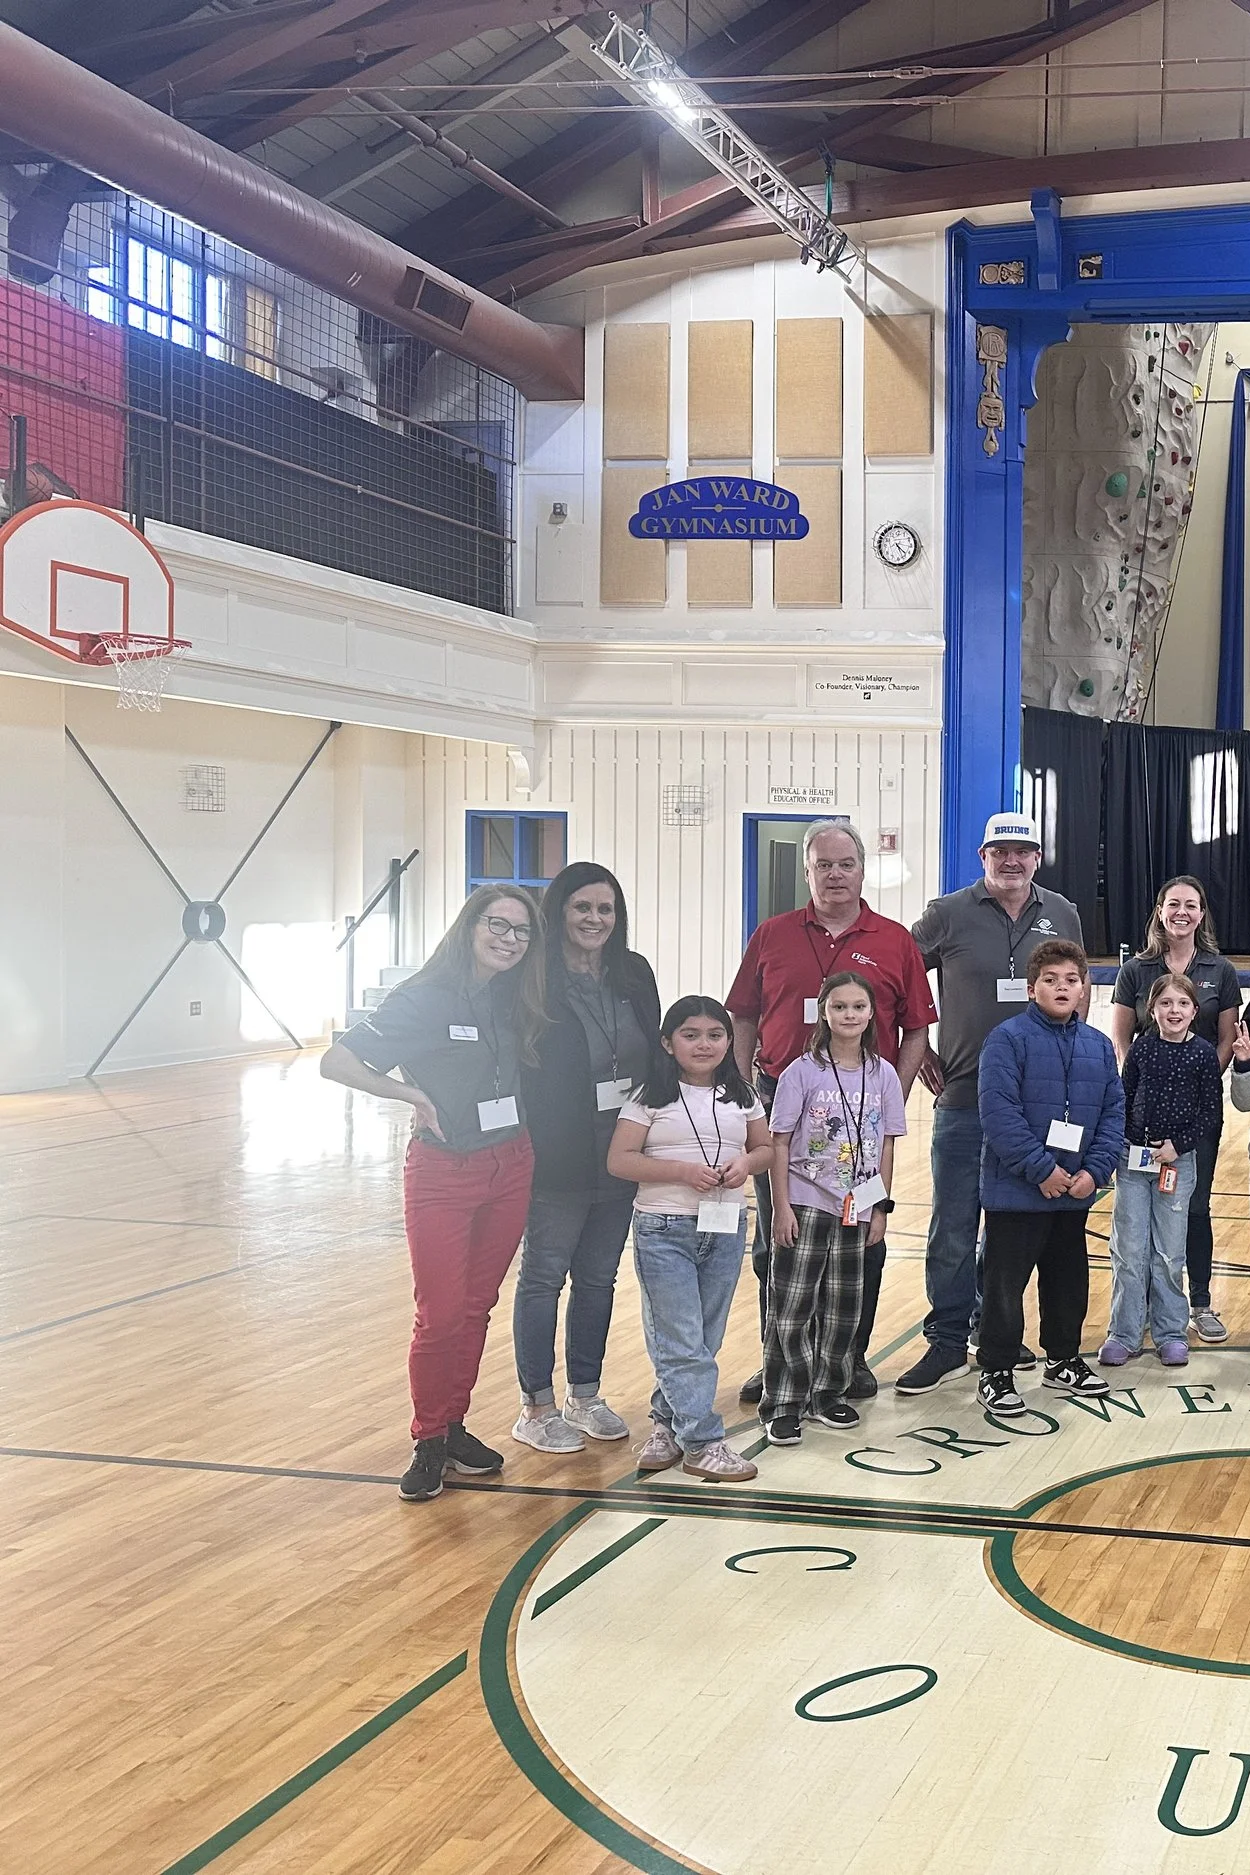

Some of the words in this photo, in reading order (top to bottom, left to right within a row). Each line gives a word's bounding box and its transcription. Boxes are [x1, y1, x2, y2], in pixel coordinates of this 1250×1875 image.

[652, 482, 700, 511] JAN
[709, 481, 790, 510] WARD
[640, 516, 797, 535] GYMNASIUM
[866, 675, 893, 683] Maloney
[888, 683, 920, 692] Champion
[770, 786, 800, 795] PHYSICAL
[809, 788, 834, 797] HEALTH
[773, 795, 807, 803] EDUCATION
[809, 797, 831, 805] OFFICE
[994, 825, 1030, 835] BRUINS
